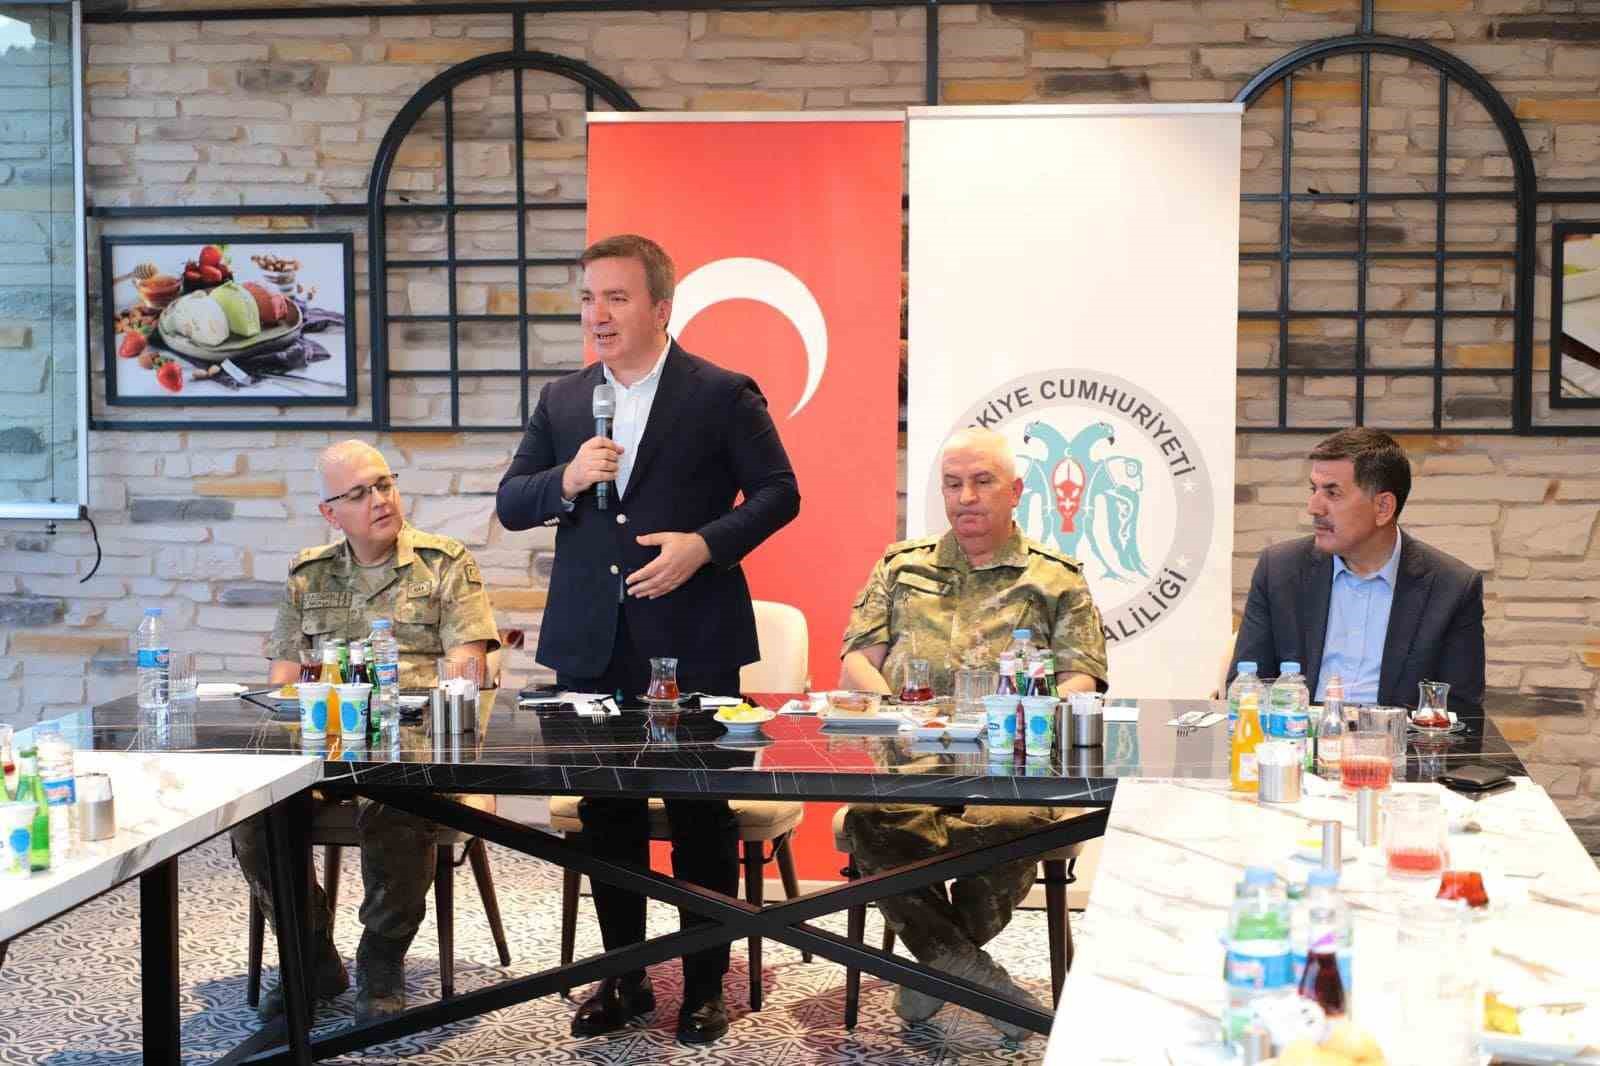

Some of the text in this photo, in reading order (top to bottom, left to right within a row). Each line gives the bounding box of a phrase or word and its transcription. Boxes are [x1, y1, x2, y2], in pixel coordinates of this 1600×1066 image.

[967, 378, 1196, 477] KİYE CUMHURİYETİ
[1103, 567, 1187, 642] ALİLİĞİ
